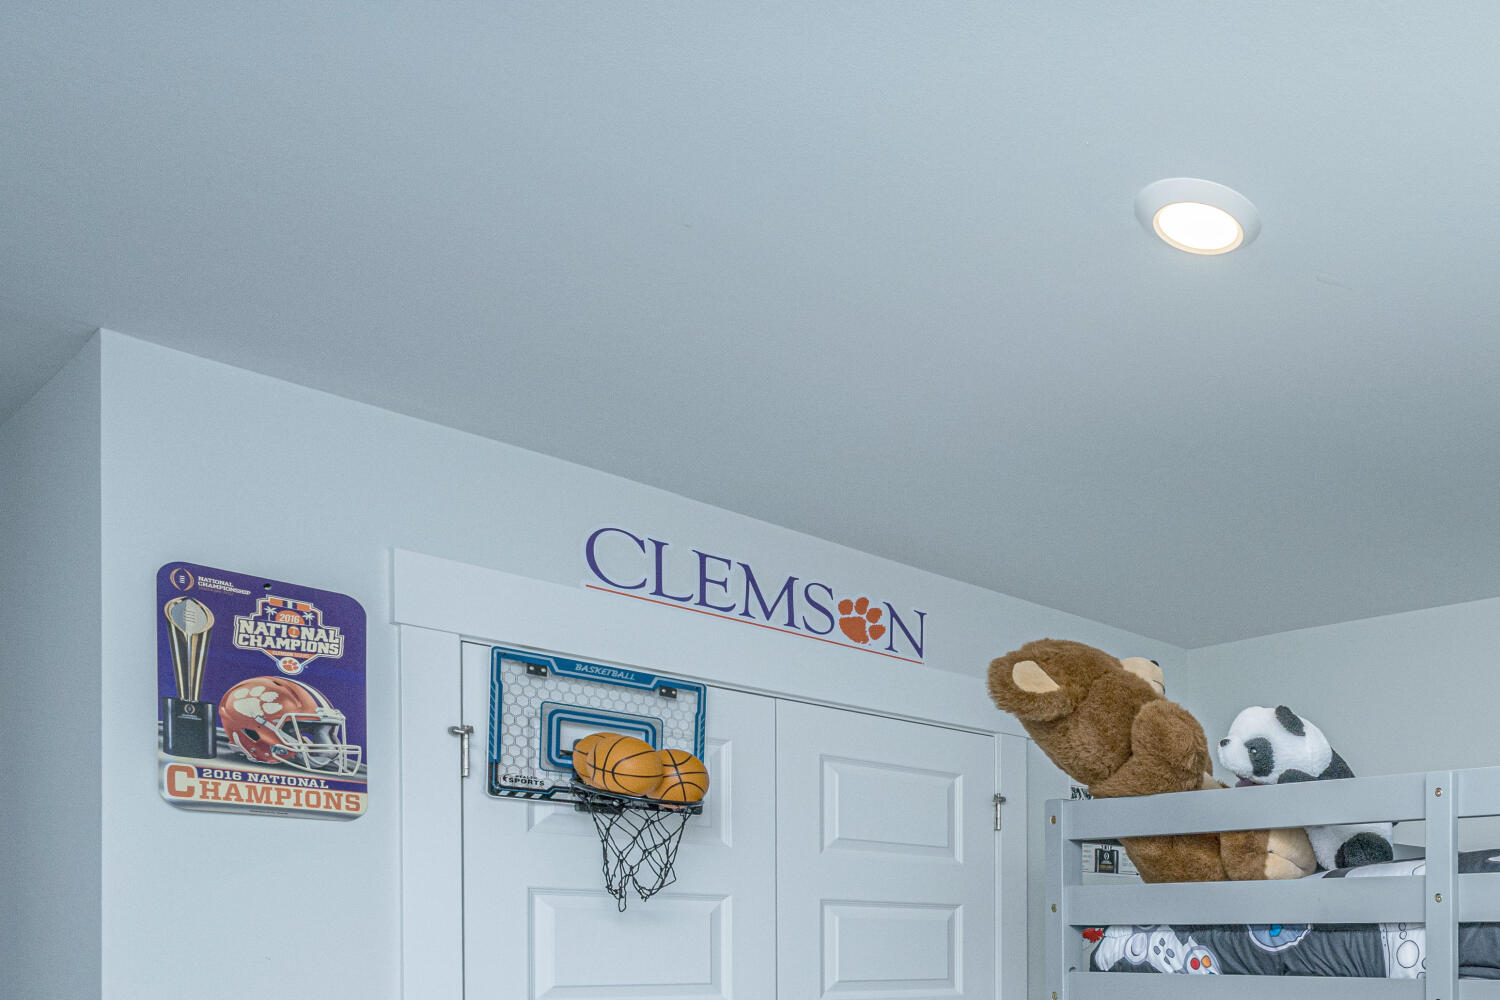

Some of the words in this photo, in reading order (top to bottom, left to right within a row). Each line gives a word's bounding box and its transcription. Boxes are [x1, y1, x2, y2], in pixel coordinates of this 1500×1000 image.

[197, 575, 234, 588] NATIONAL
[197, 581, 252, 596] CHAMPIONSHIP
[279, 613, 301, 624] 2016
[239, 619, 340, 644] NATIONAL
[238, 633, 340, 655] CHAMPIONS
[575, 663, 636, 680] BASKETBALL
[202, 768, 242, 779] 2016
[243, 772, 330, 789] NATIONAL
[508, 777, 545, 786] SPORTS
[166, 764, 361, 812] CHAMPIONS
